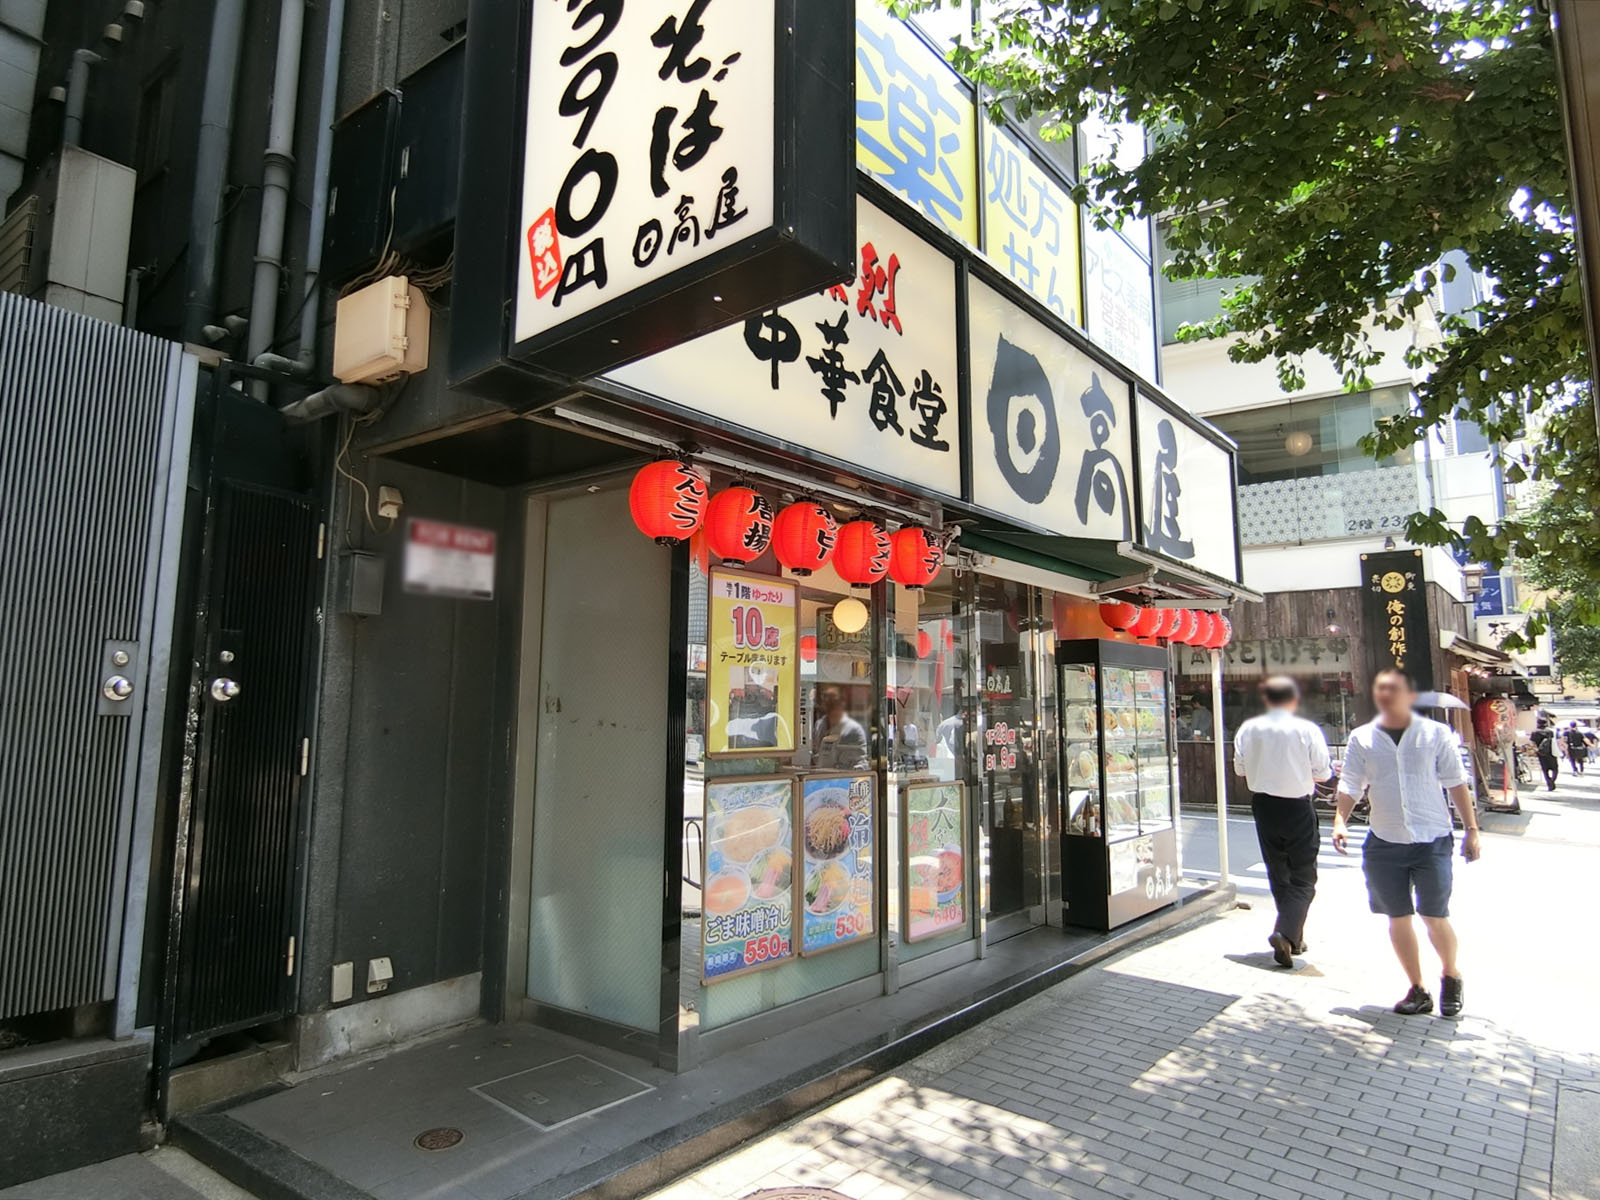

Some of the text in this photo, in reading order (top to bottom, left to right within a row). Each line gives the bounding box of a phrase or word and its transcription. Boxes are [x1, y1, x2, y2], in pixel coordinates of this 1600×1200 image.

[632, 166, 748, 268] 日高屋
[743, 306, 950, 452] 中華食堂
[986, 332, 1195, 560] 日高屋
[743, 494, 774, 554] 唐揚
[732, 605, 780, 649] 10席
[705, 904, 792, 944] ごま味噌冷し
